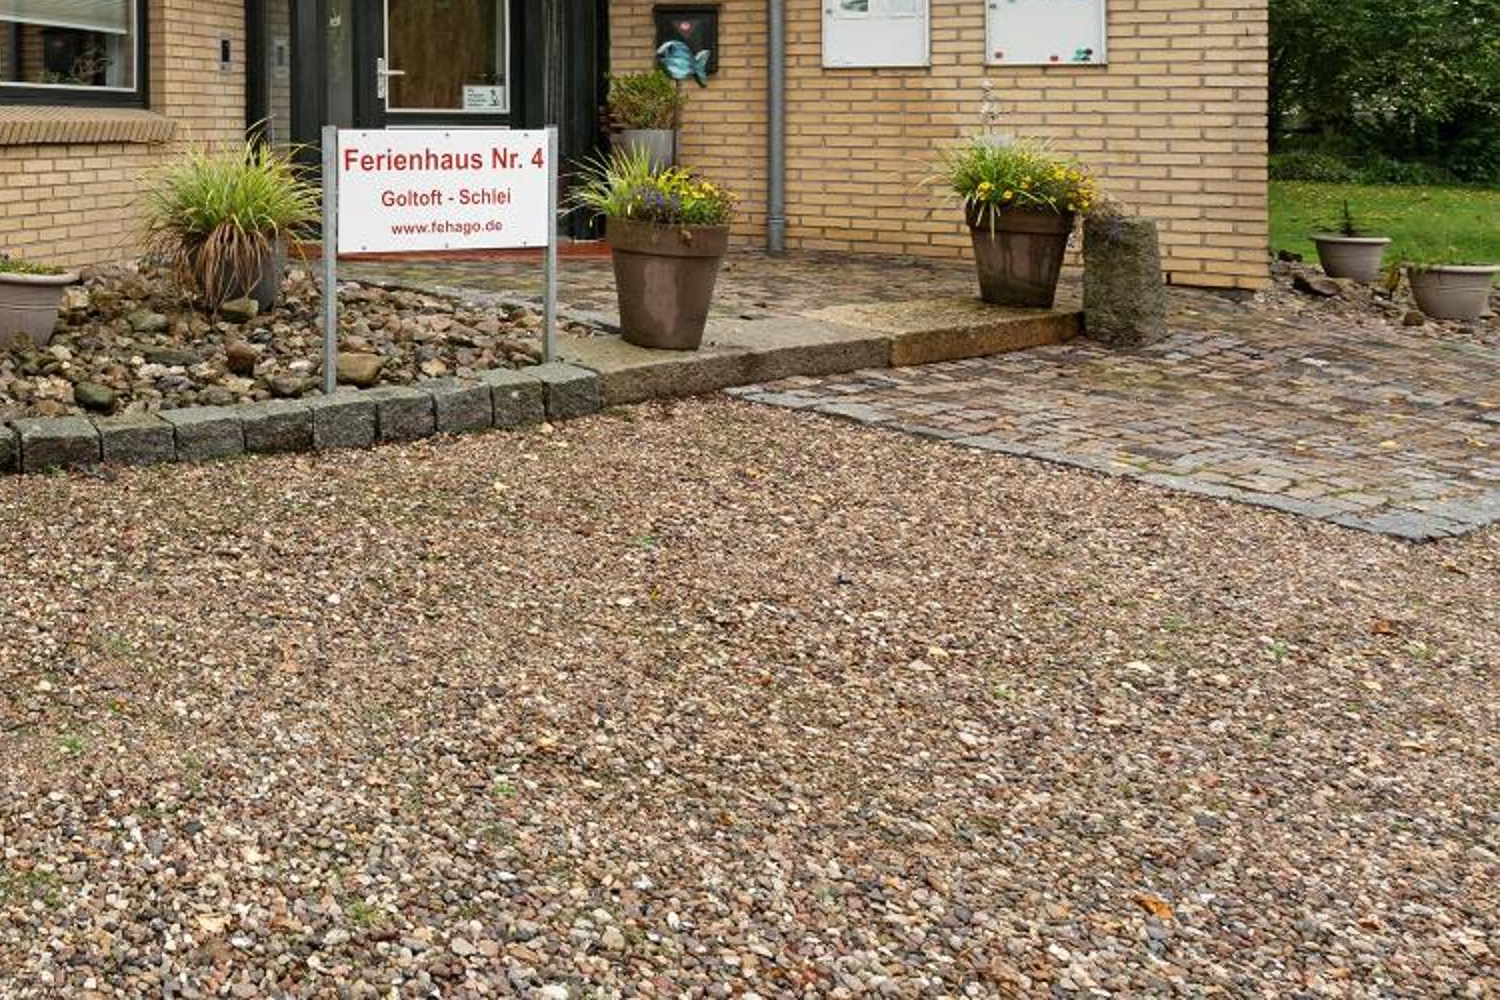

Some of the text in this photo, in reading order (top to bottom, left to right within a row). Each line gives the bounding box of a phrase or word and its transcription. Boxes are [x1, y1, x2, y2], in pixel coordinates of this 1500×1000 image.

[344, 147, 544, 171] Ferienhaus Nr. 4
[381, 189, 443, 207] Goltoft
[459, 187, 512, 206] Schlei
[391, 219, 503, 235] www.fehago.de
